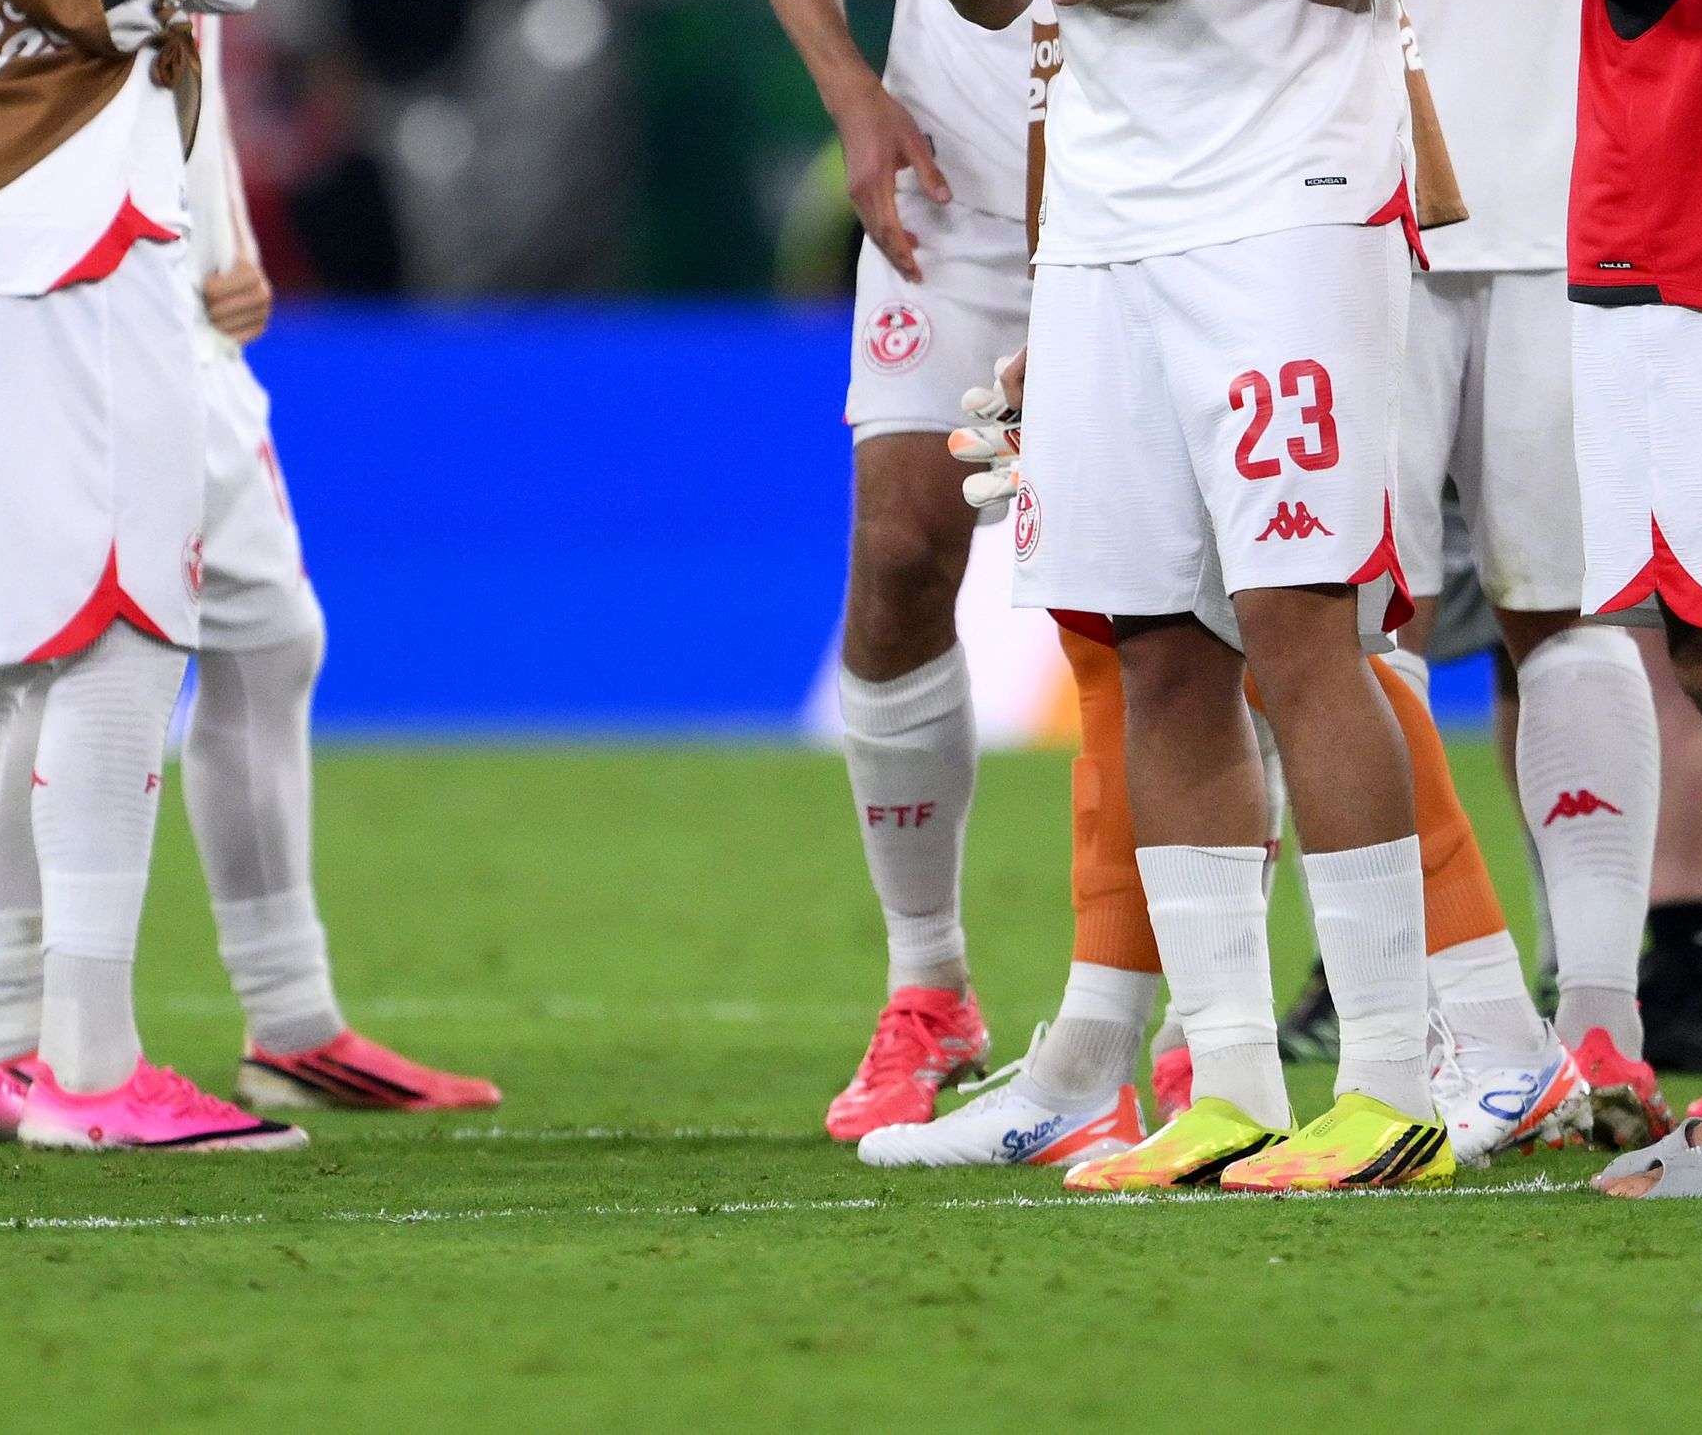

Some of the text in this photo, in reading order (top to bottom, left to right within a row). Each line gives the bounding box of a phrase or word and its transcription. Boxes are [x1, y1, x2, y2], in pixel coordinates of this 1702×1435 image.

[1306, 177, 1345, 186] KOMBAT
[1229, 359, 1340, 481] 23
[866, 801, 937, 829] FTF
